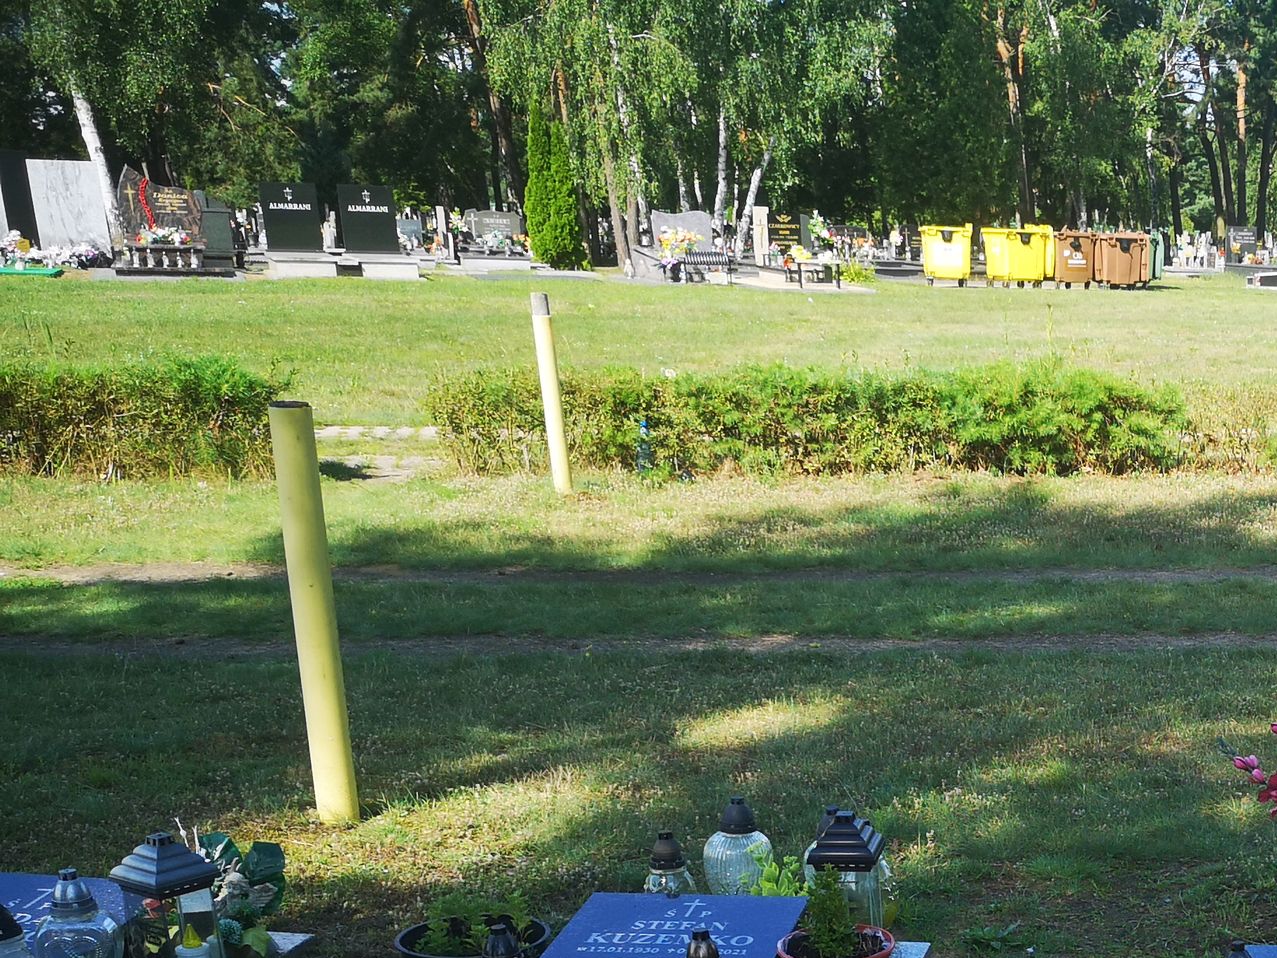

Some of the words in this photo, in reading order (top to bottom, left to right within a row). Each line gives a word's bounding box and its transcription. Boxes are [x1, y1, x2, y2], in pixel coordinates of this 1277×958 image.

[269, 202, 311, 210] ALMARRANI
[347, 204, 389, 213] ALMARRANI
[631, 920, 729, 931] STEFAN
